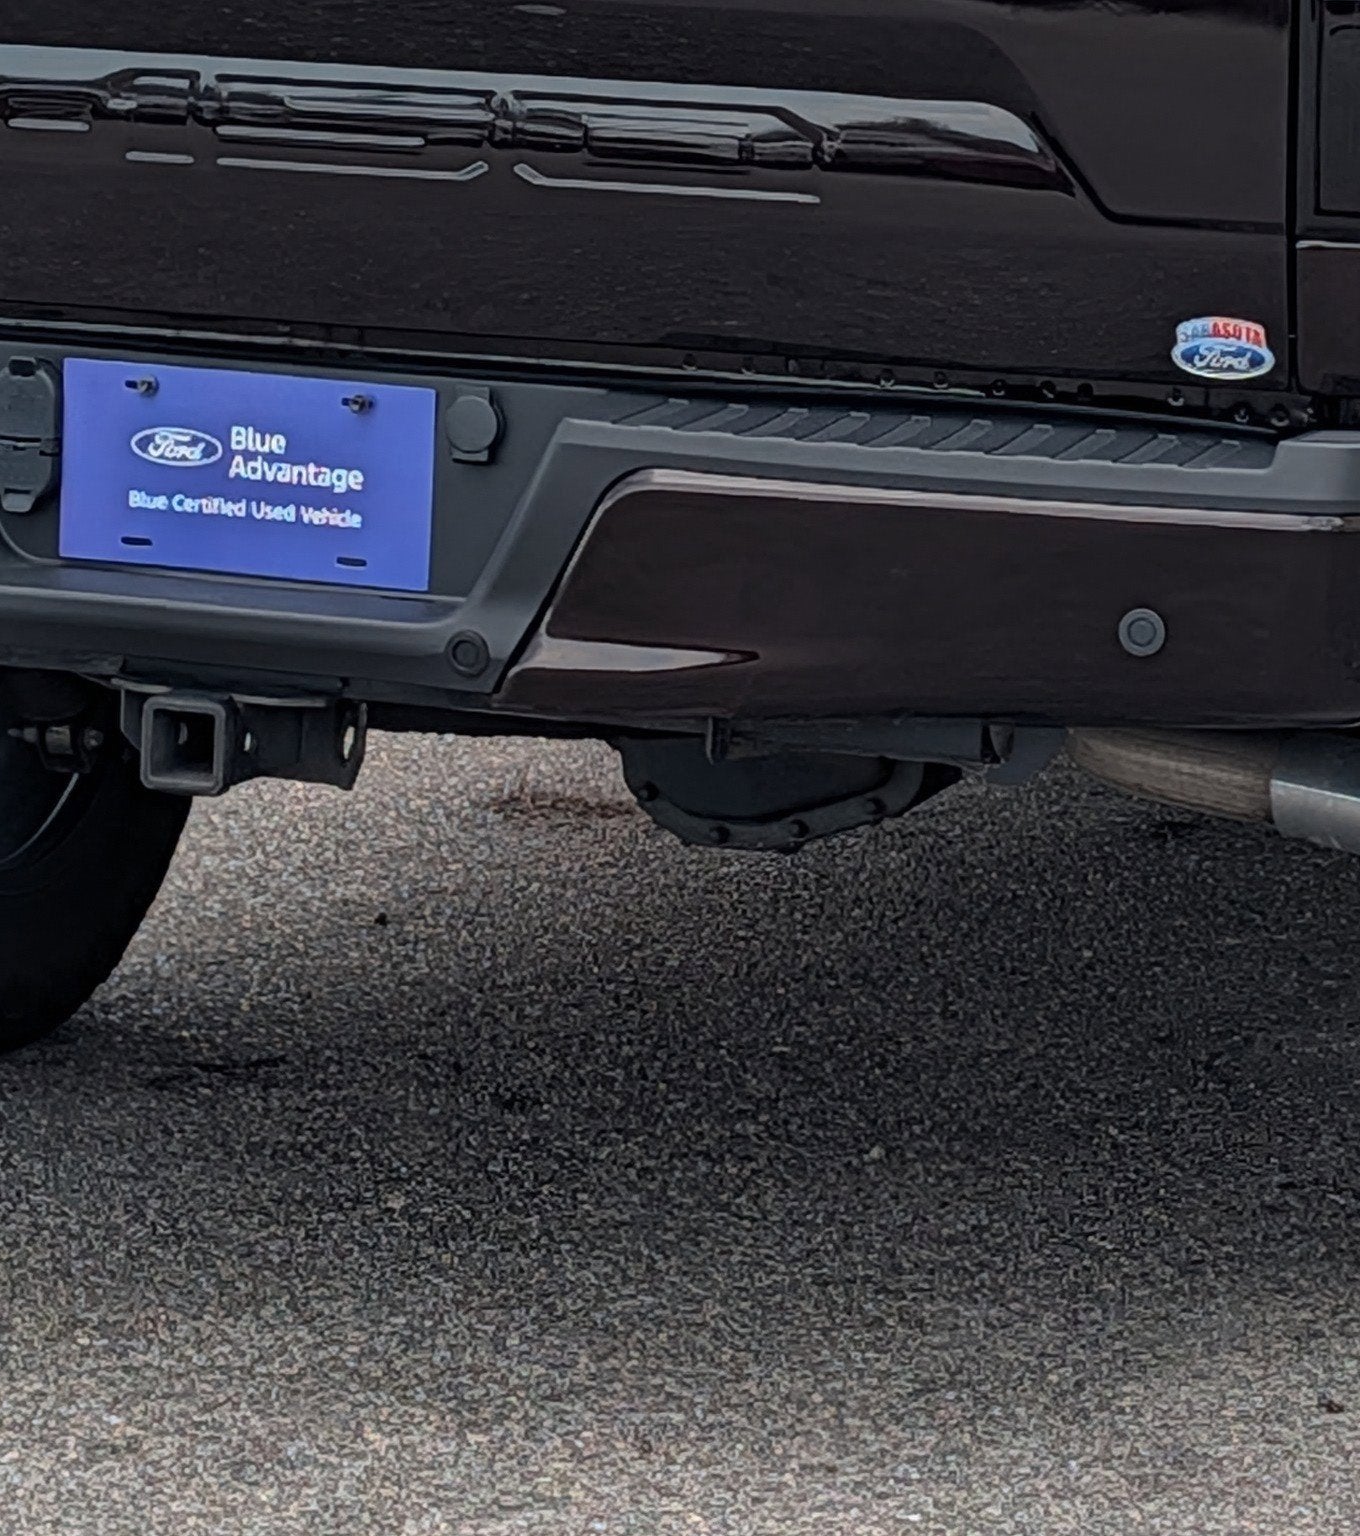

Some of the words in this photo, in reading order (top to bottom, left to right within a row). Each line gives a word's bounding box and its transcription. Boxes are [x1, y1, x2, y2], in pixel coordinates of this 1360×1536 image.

[1193, 344, 1253, 370] Ford
[147, 430, 205, 461] Ford
[230, 425, 287, 454] Blue
[229, 455, 365, 494] Advantage
[129, 490, 168, 510] Blue
[172, 494, 247, 518] Certified
[251, 501, 297, 522] Used
[300, 506, 362, 528] Vehicle
